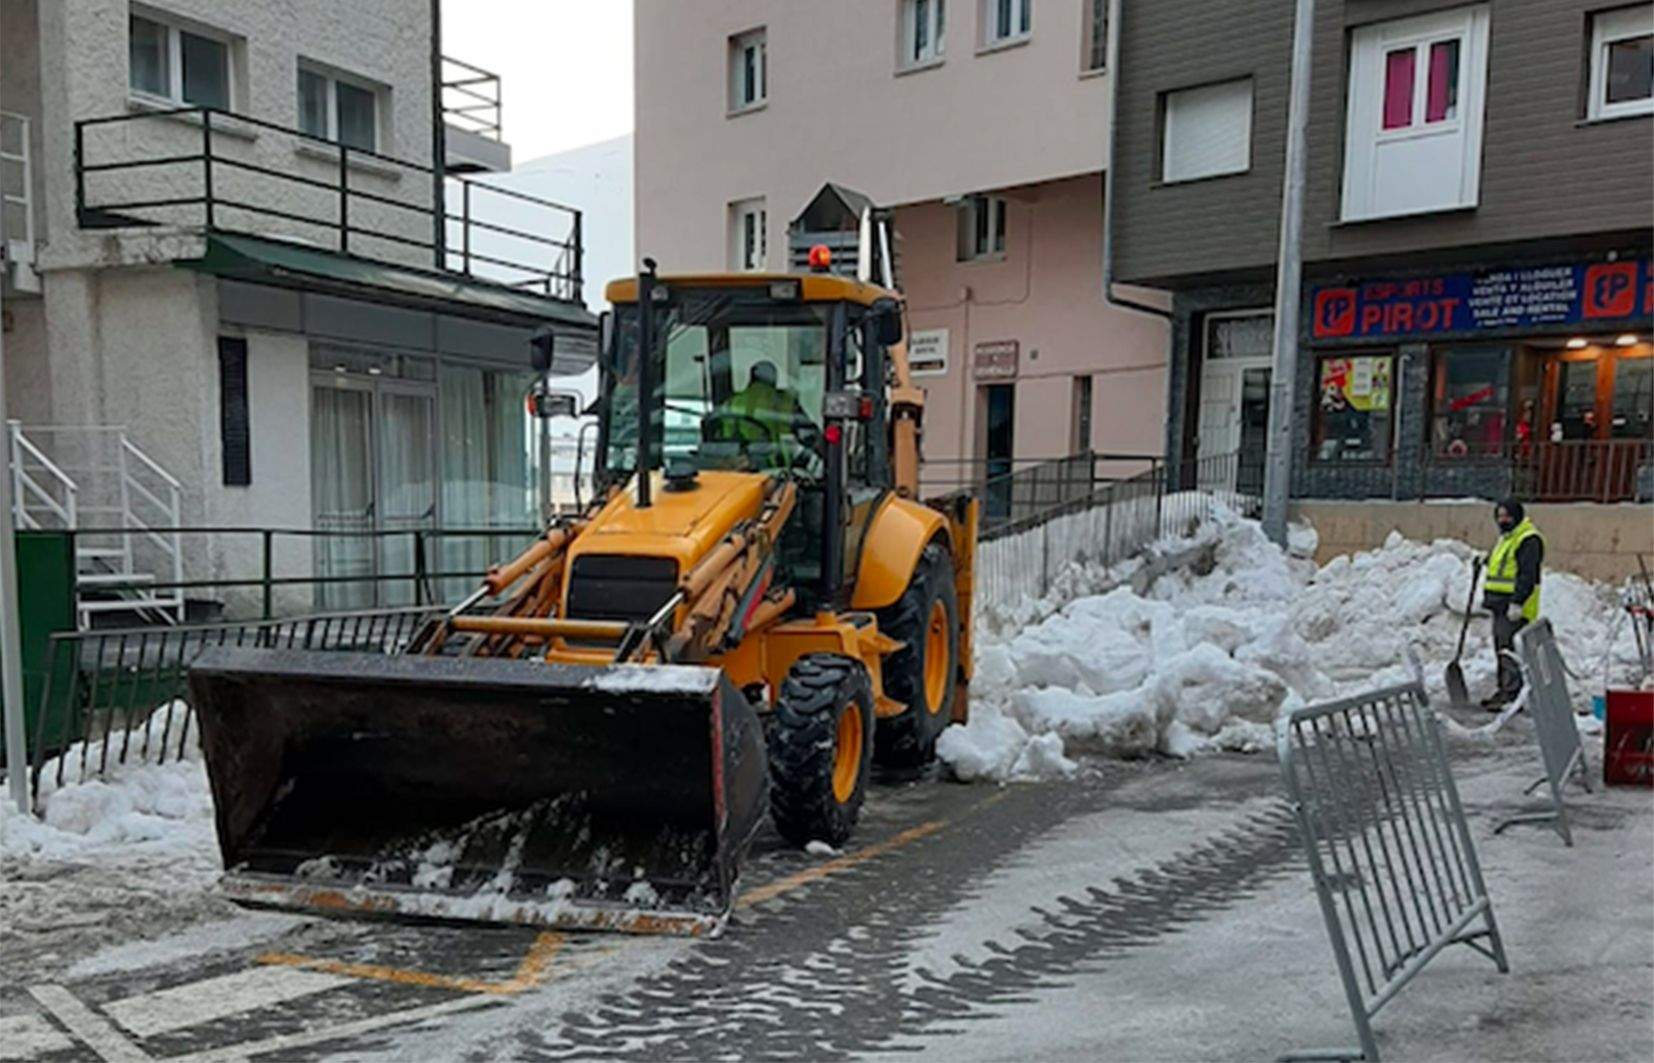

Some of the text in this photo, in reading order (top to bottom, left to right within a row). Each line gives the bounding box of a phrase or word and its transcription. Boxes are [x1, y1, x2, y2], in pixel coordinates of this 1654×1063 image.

[1521, 291, 1577, 304] LOCATION
[1361, 297, 1459, 333] PIROT
[1502, 306, 1524, 316] AND
